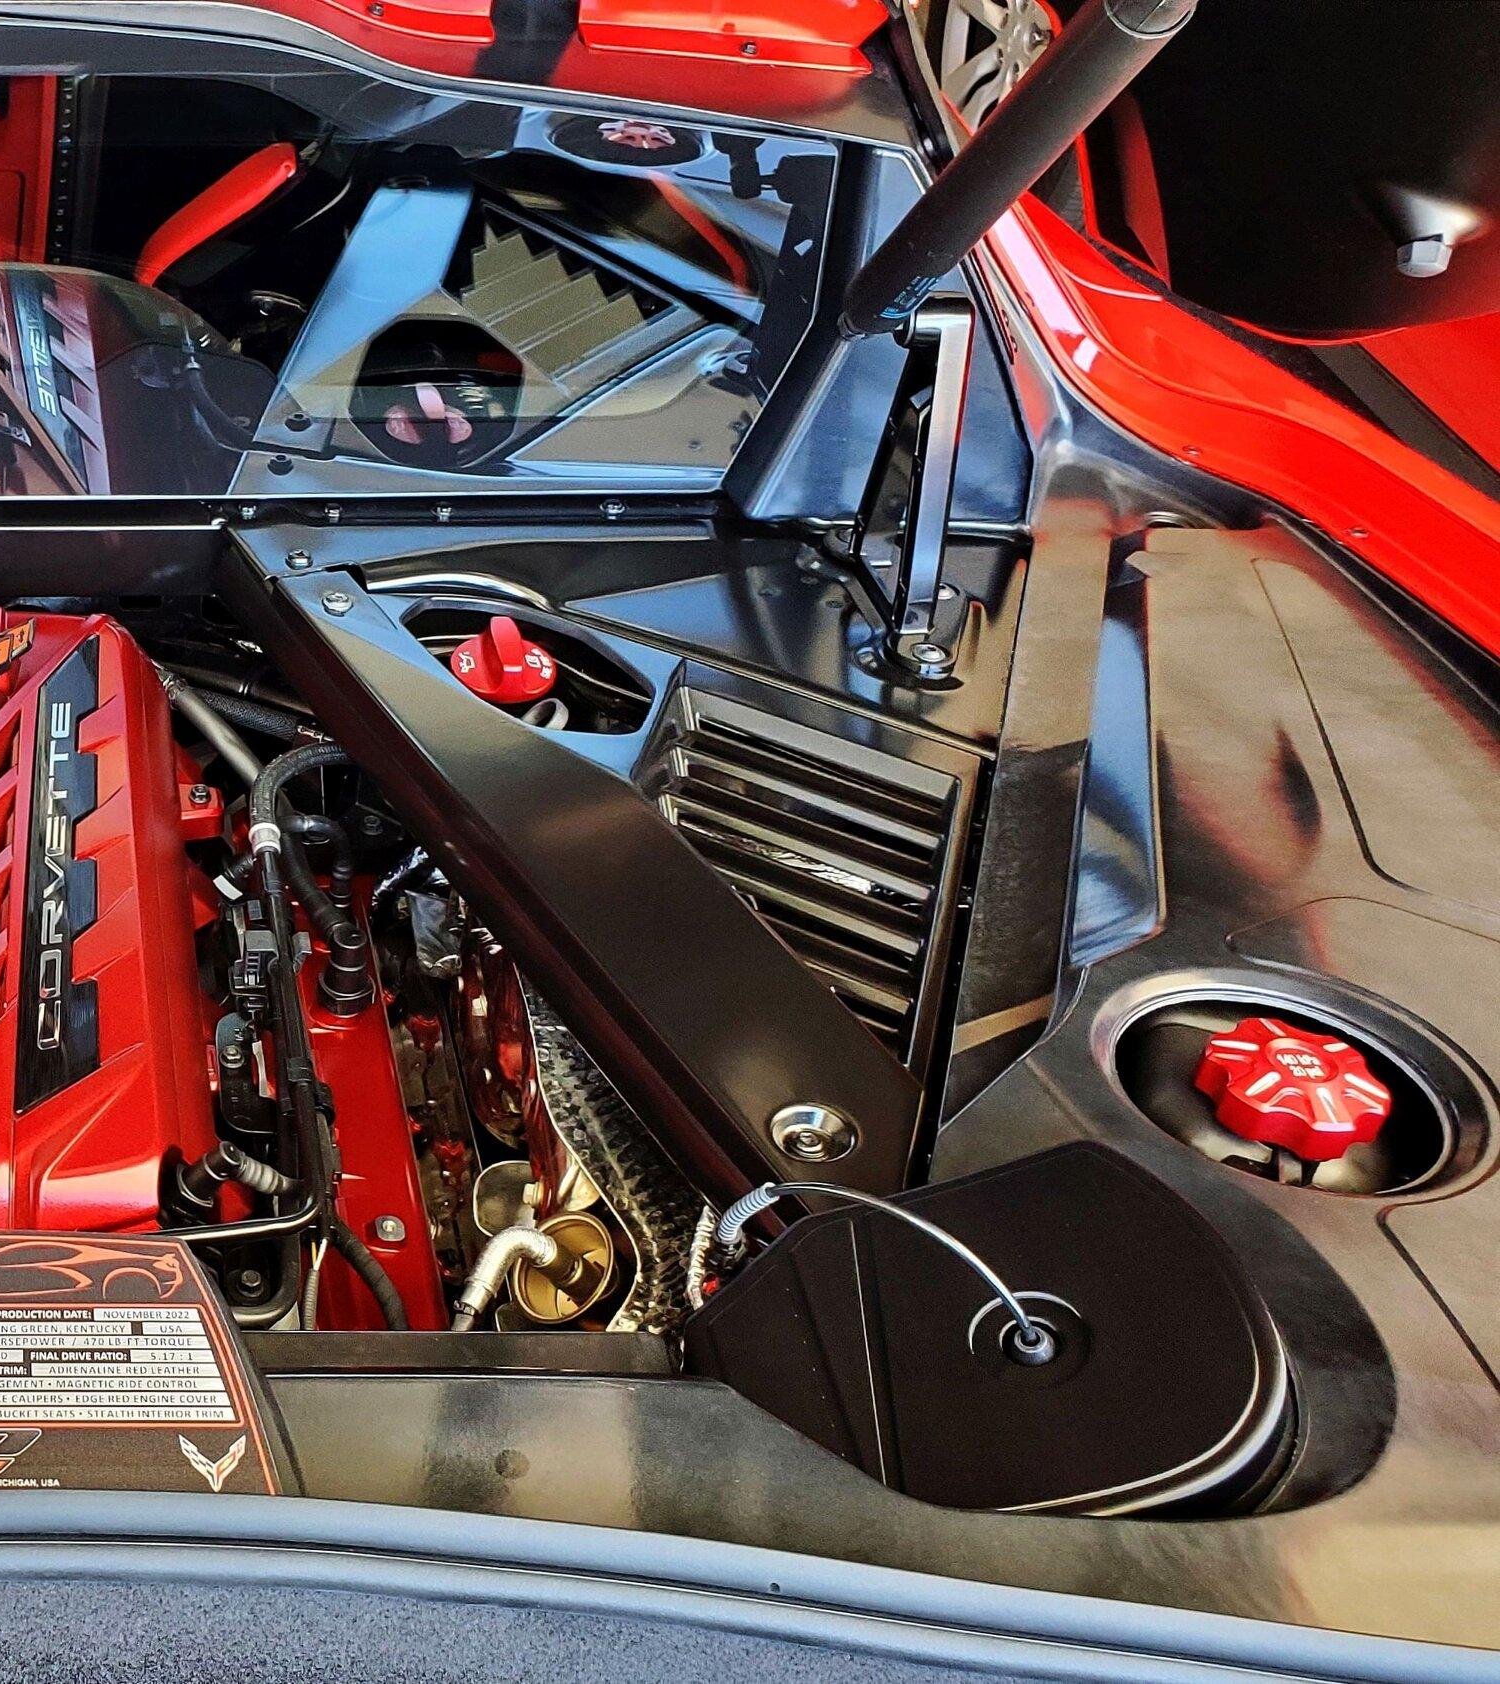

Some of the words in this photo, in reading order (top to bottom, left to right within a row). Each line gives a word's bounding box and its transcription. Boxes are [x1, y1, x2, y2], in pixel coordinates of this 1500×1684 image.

[37, 702, 71, 1051] CORVETTE
[63, 1310, 92, 1319] DATE:
[103, 1310, 162, 1319] NOVEMBER
[165, 1310, 190, 1319] 2022
[21, 1324, 63, 1334] GREEN,
[66, 1324, 125, 1333] KENTUCKY
[159, 1325, 183, 1333] USA
[83, 1337, 104, 1346] 470
[143, 1338, 193, 1346] TORQUE
[30, 1351, 60, 1361] FINAL
[62, 1351, 92, 1361] DRIVE
[94, 1351, 128, 1361] RATIO:
[49, 1365, 122, 1374] ADRENALINE
[125, 1365, 147, 1374] RED
[151, 1365, 200, 1374] LEATHER
[56, 1380, 115, 1388] MAGNETIC
[118, 1380, 142, 1388] RIDE
[147, 1380, 198, 1388] CONTROL
[11, 1395, 63, 1403] CALIPERS
[75, 1395, 104, 1403] EDGE
[108, 1395, 130, 1403] RED
[133, 1395, 176, 1403] ENGINE
[179, 1395, 217, 1403] COVER
[42, 1410, 75, 1418] SEATS
[87, 1410, 134, 1418] STEALTH
[138, 1410, 191, 1418] INTERIOR
[195, 1410, 224, 1418] TRIM
[41, 1478, 60, 1487] USA
